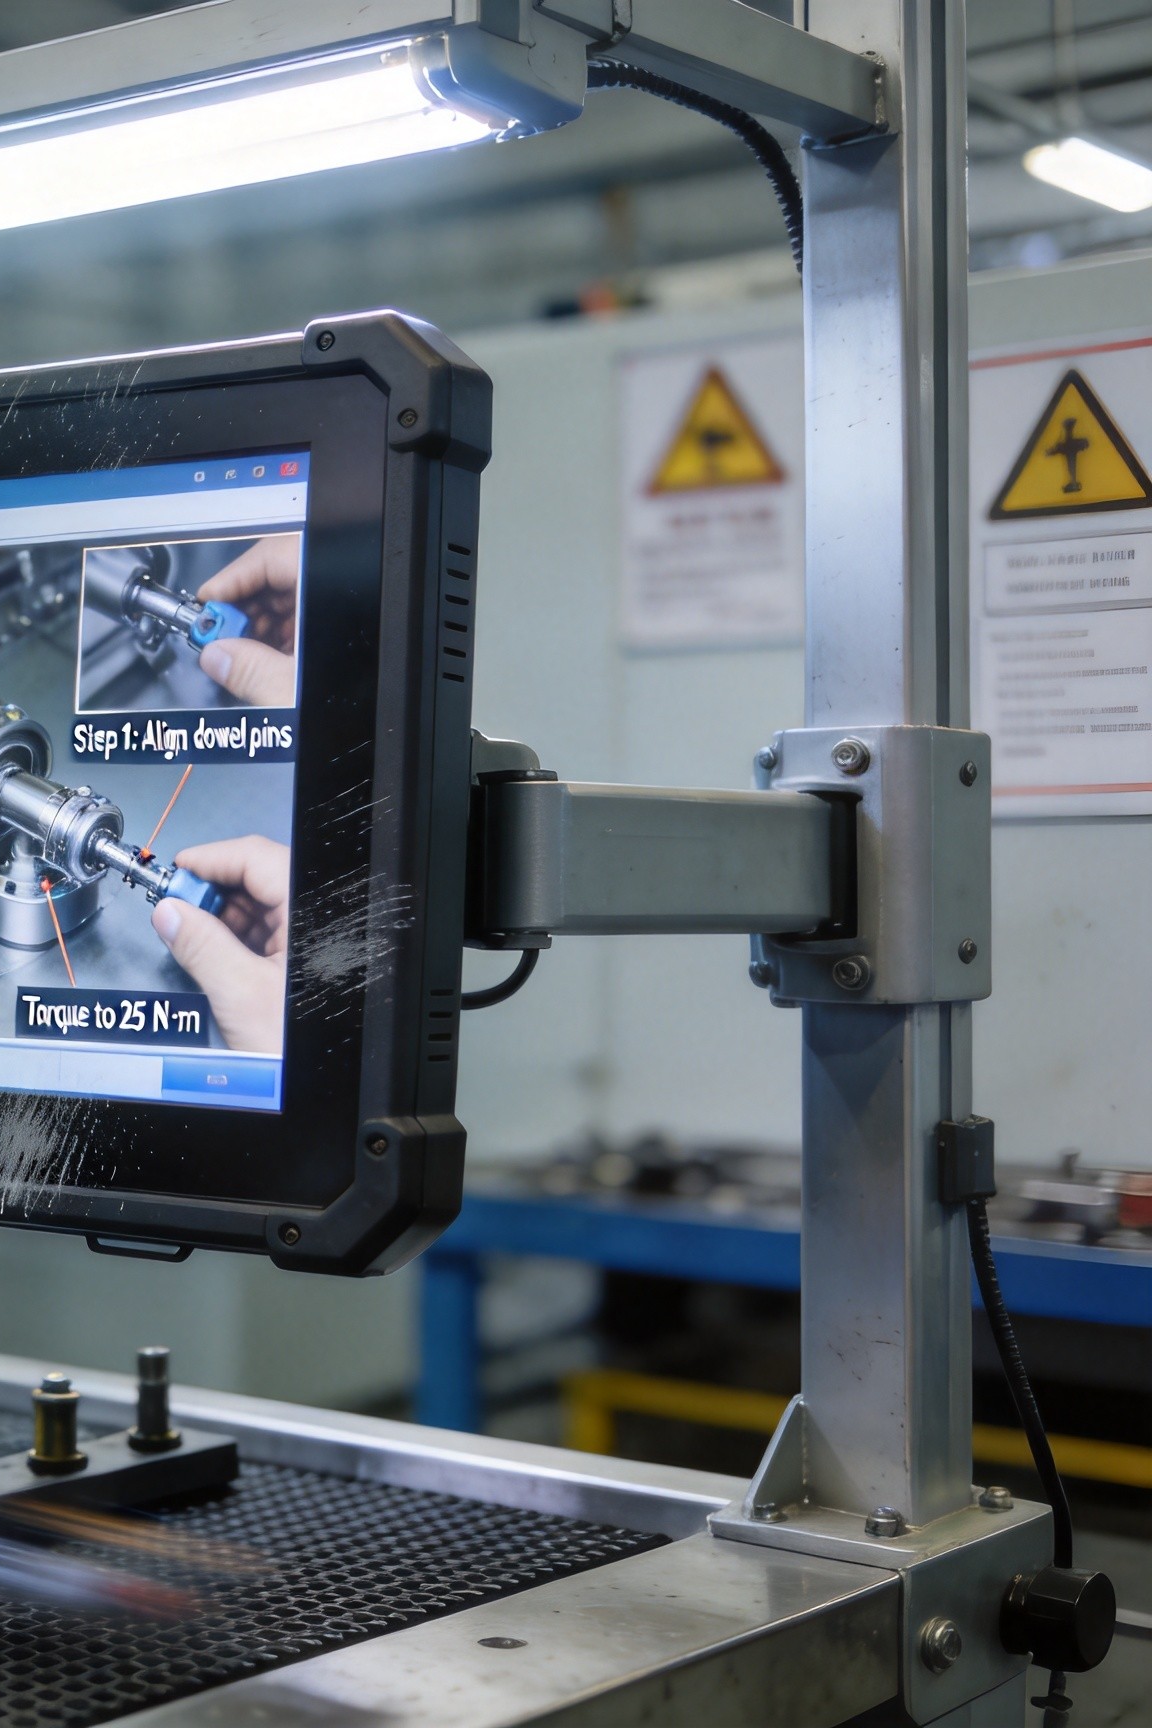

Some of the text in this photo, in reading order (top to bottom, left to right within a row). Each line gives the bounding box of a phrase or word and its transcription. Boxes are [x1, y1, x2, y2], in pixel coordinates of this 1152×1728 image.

[73, 723, 118, 760] Step
[121, 721, 139, 751] 1:
[193, 716, 247, 750] dowel
[248, 717, 293, 758] pins
[21, 995, 90, 1035] Torque
[94, 1001, 117, 1030] to
[118, 999, 147, 1032] 25
